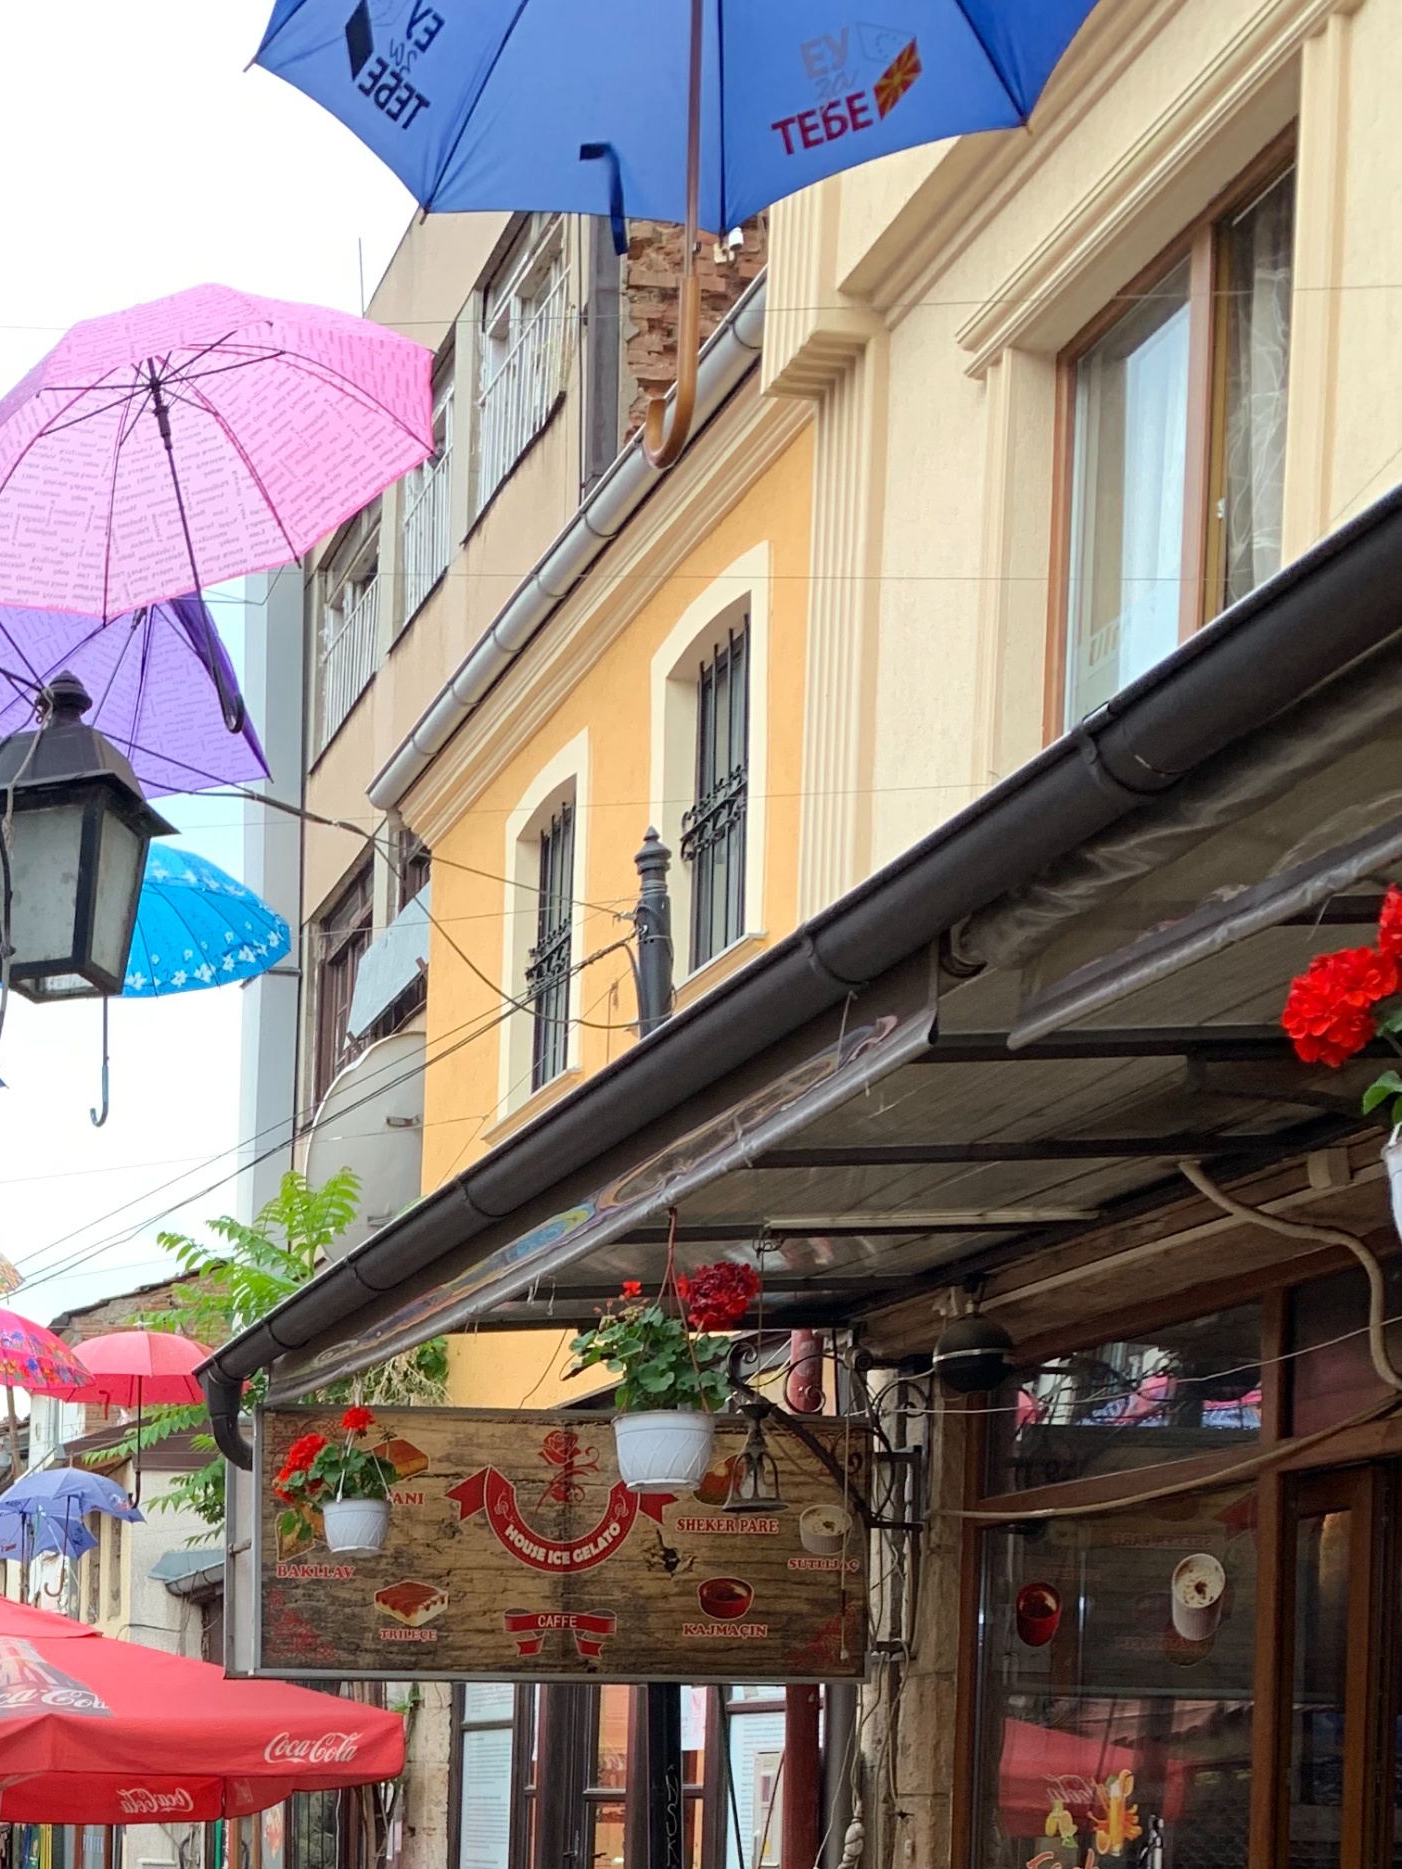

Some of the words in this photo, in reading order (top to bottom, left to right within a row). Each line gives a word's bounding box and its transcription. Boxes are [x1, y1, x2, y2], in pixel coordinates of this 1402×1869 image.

[771, 90, 874, 156] ТЕБЕ
[676, 1517, 737, 1533] SHEKER
[738, 1518, 779, 1534] PARE
[504, 1523, 547, 1562] HOUSE
[547, 1551, 571, 1565] ICE
[572, 1521, 621, 1563] GELATO
[537, 1614, 578, 1628] CAFFE
[379, 1627, 438, 1643] TRILEÇE
[682, 1623, 768, 1640] KAJMAÇIN
[264, 1732, 364, 1764] Coca-Cola
